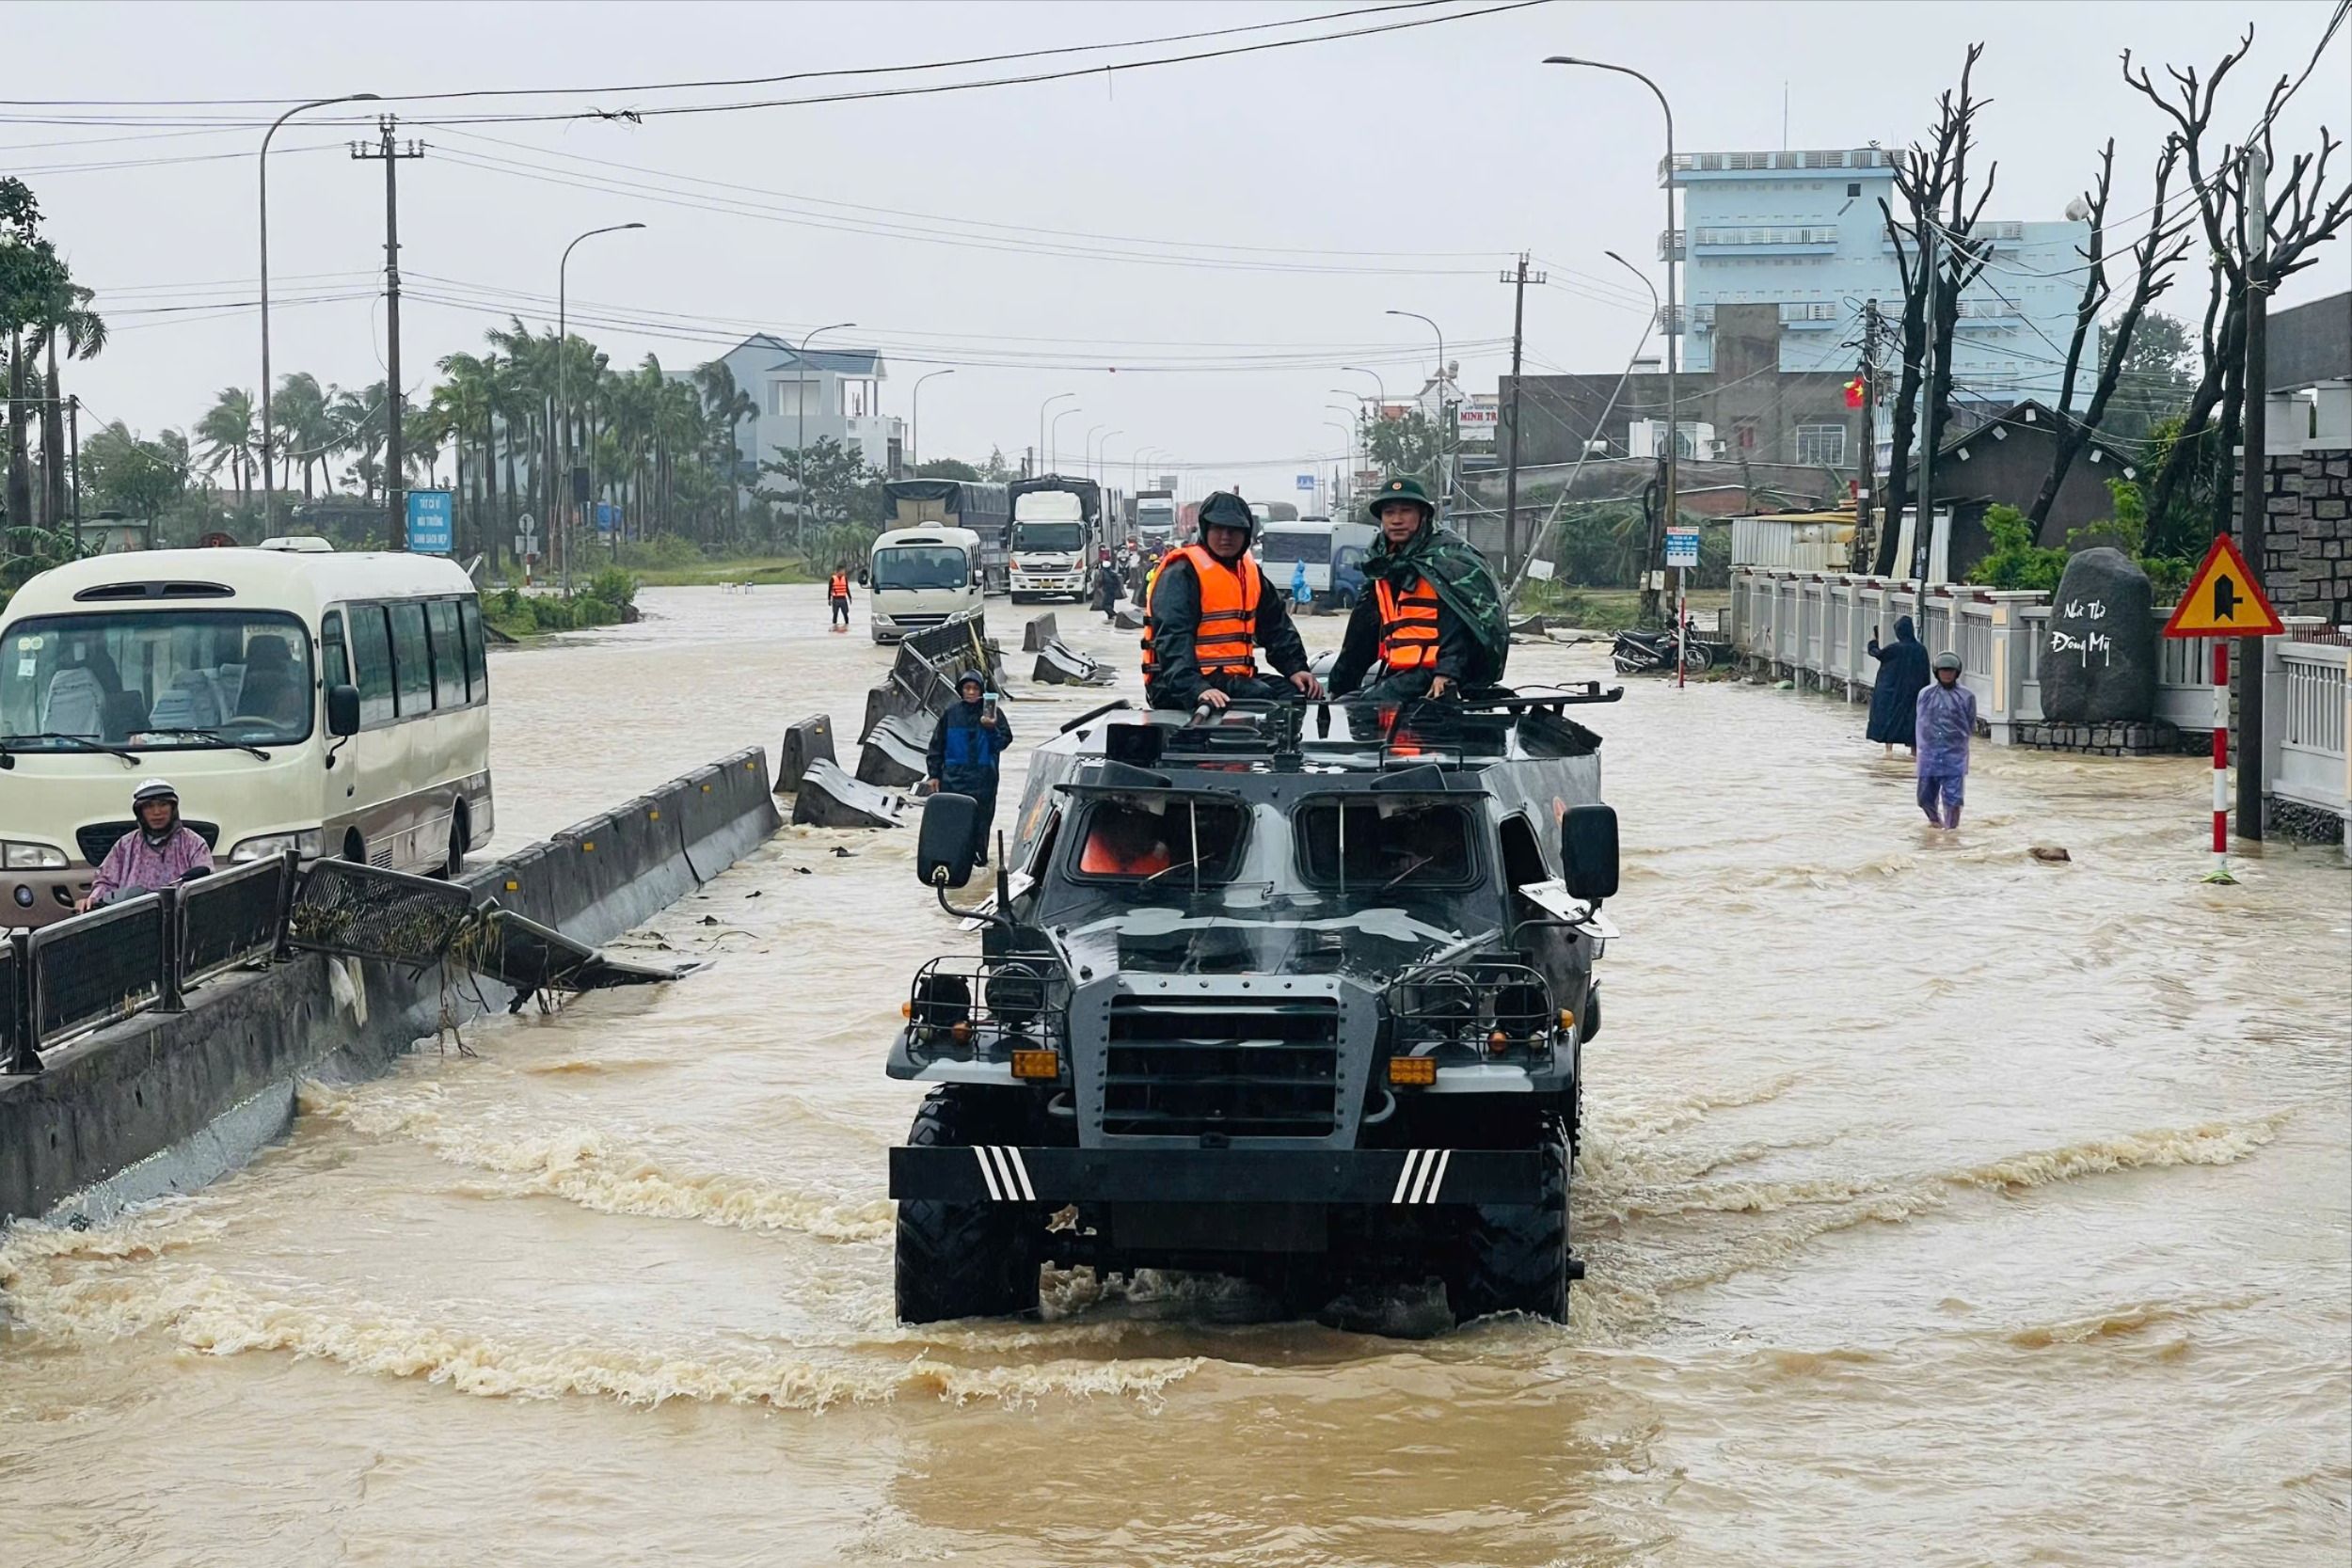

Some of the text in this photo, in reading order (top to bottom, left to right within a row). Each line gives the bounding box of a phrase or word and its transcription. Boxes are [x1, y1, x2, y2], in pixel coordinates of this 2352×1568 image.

[1460, 412, 1483, 421] MINH
[2050, 631, 2112, 668] Đông Mỹ
